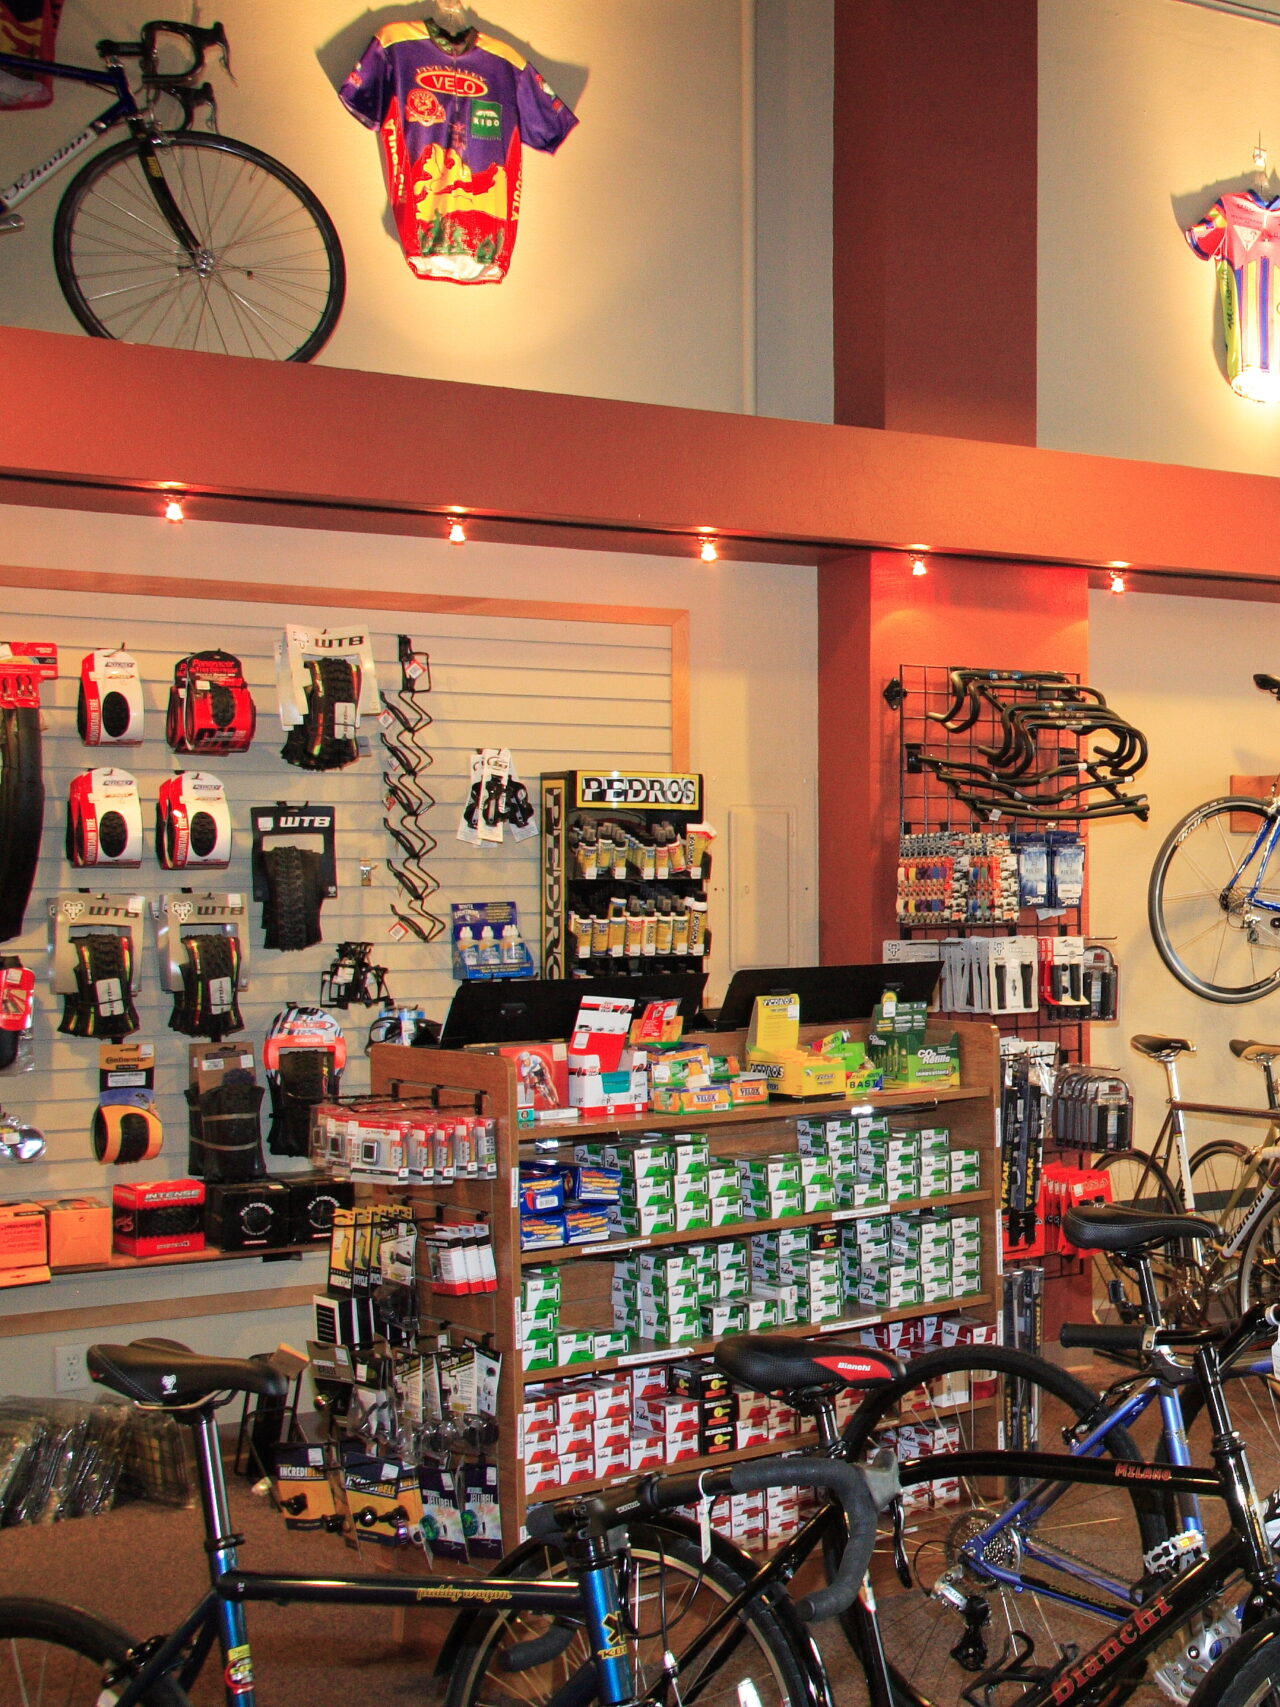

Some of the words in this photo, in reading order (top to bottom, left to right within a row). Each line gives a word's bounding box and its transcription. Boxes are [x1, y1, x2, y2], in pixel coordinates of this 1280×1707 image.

[315, 635, 364, 648] WTB
[583, 776, 695, 805] PEDRO'S
[280, 816, 331, 828] WTB
[197, 905, 244, 916] WTB
[923, 1054, 951, 1065] Refills
[144, 1189, 200, 1199] INTENSE
[838, 1362, 872, 1372] Bianchi
[1114, 1463, 1172, 1481] MILANO
[416, 1584, 463, 1602] paddy
[463, 1589, 513, 1603] wagon
